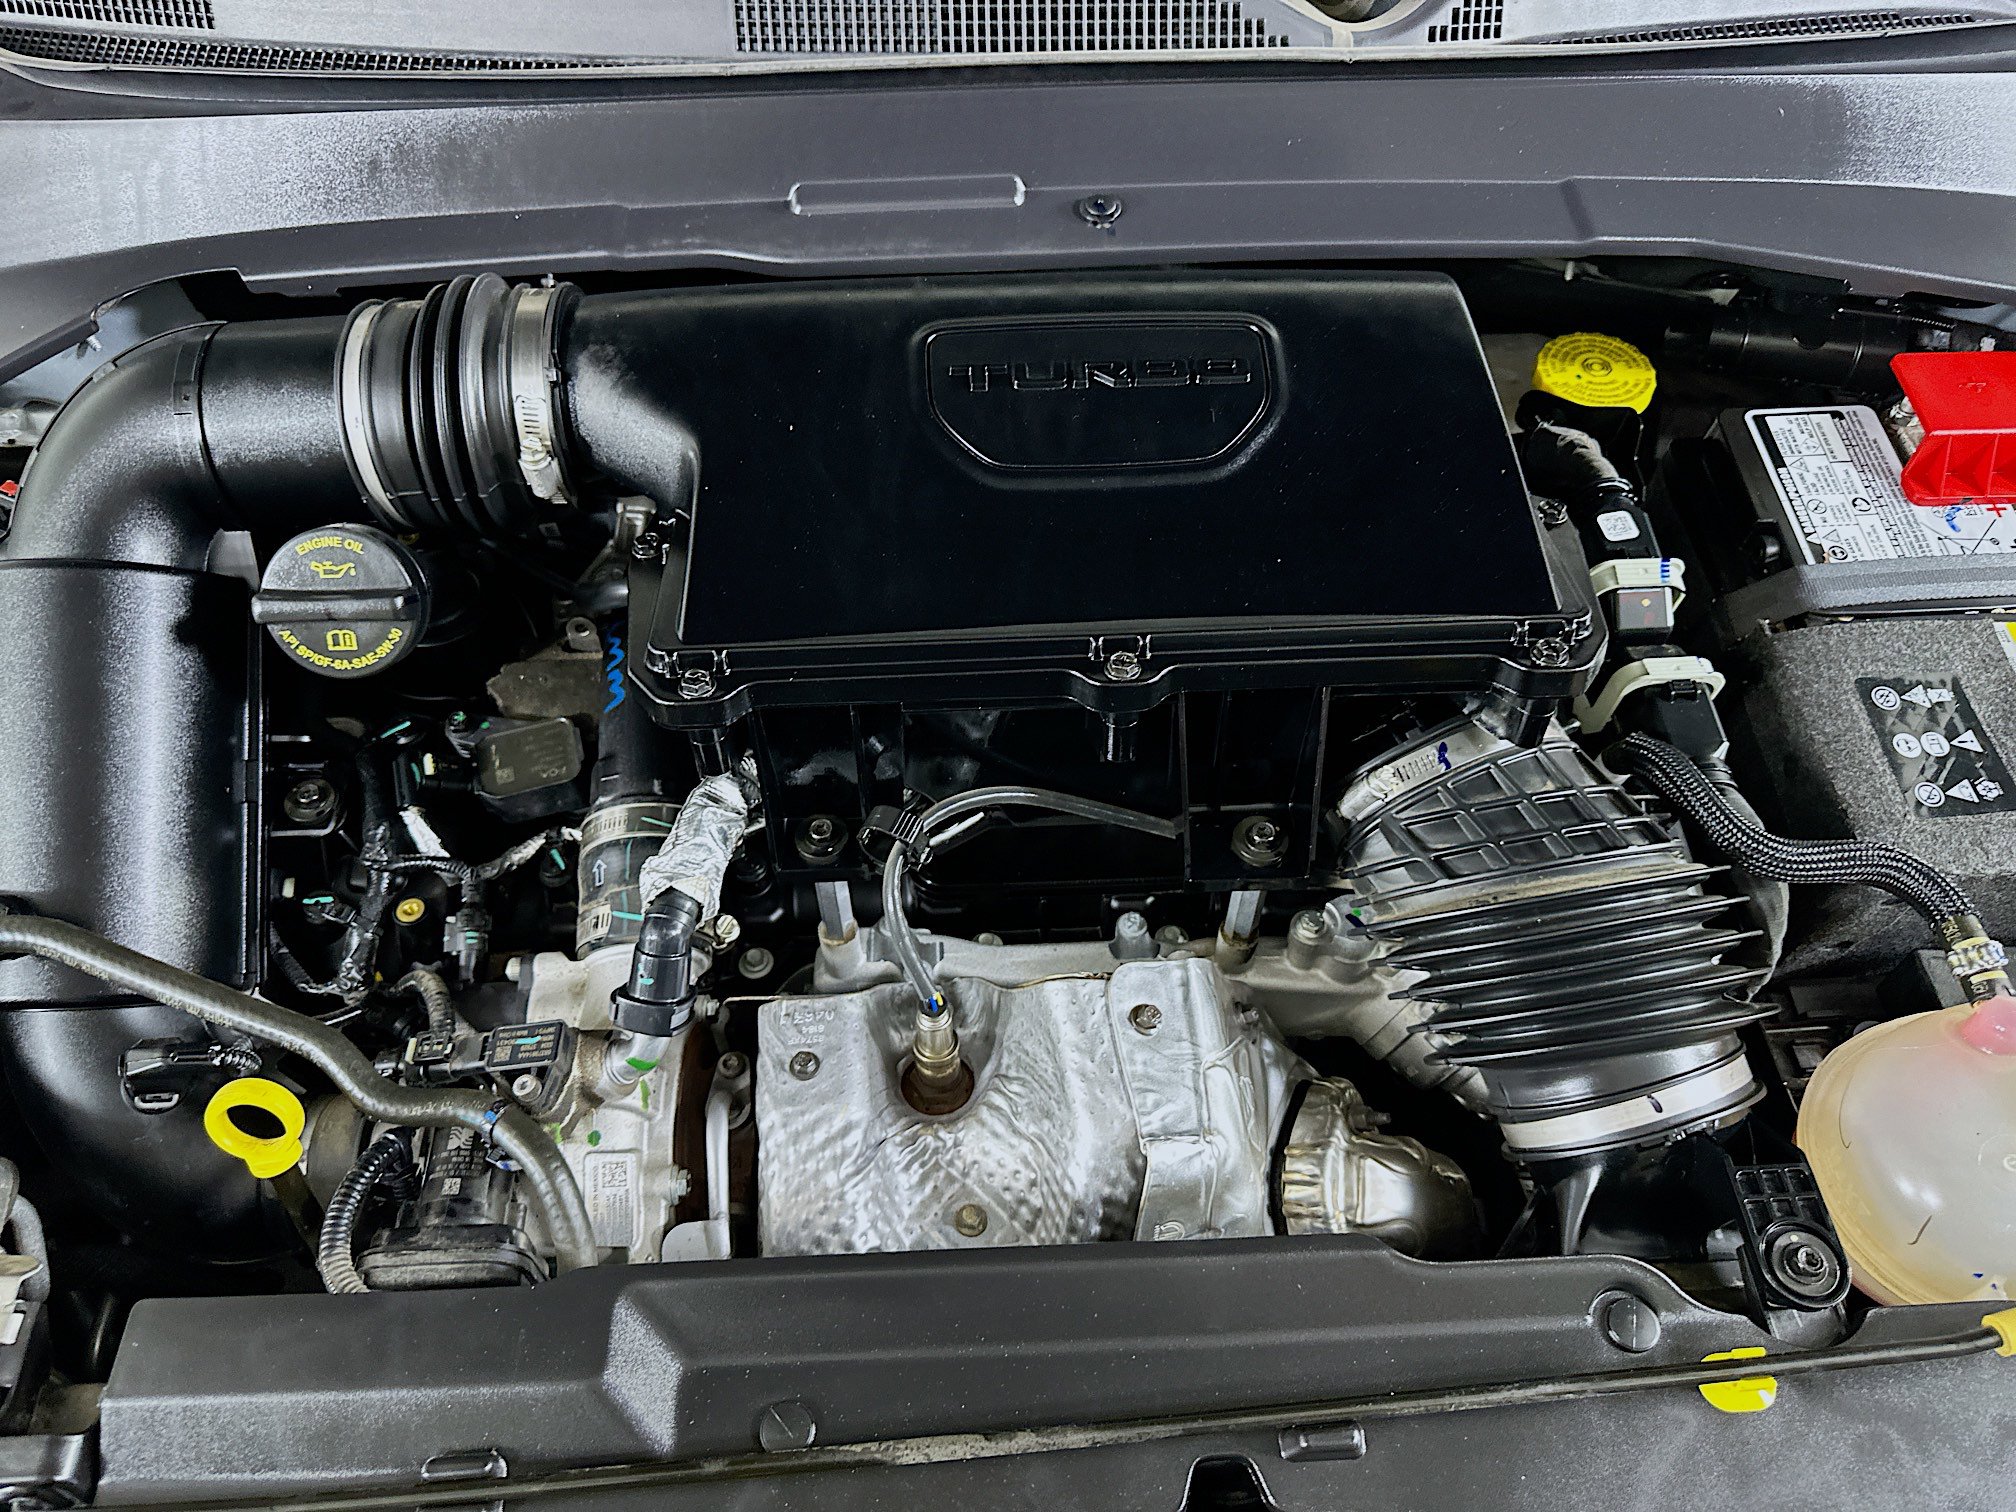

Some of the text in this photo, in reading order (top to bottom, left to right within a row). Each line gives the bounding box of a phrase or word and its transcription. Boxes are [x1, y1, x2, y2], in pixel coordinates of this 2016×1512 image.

[949, 358, 1251, 392] TURBO
[295, 536, 364, 556] ENGINE OIL
[278, 629, 297, 649] API
